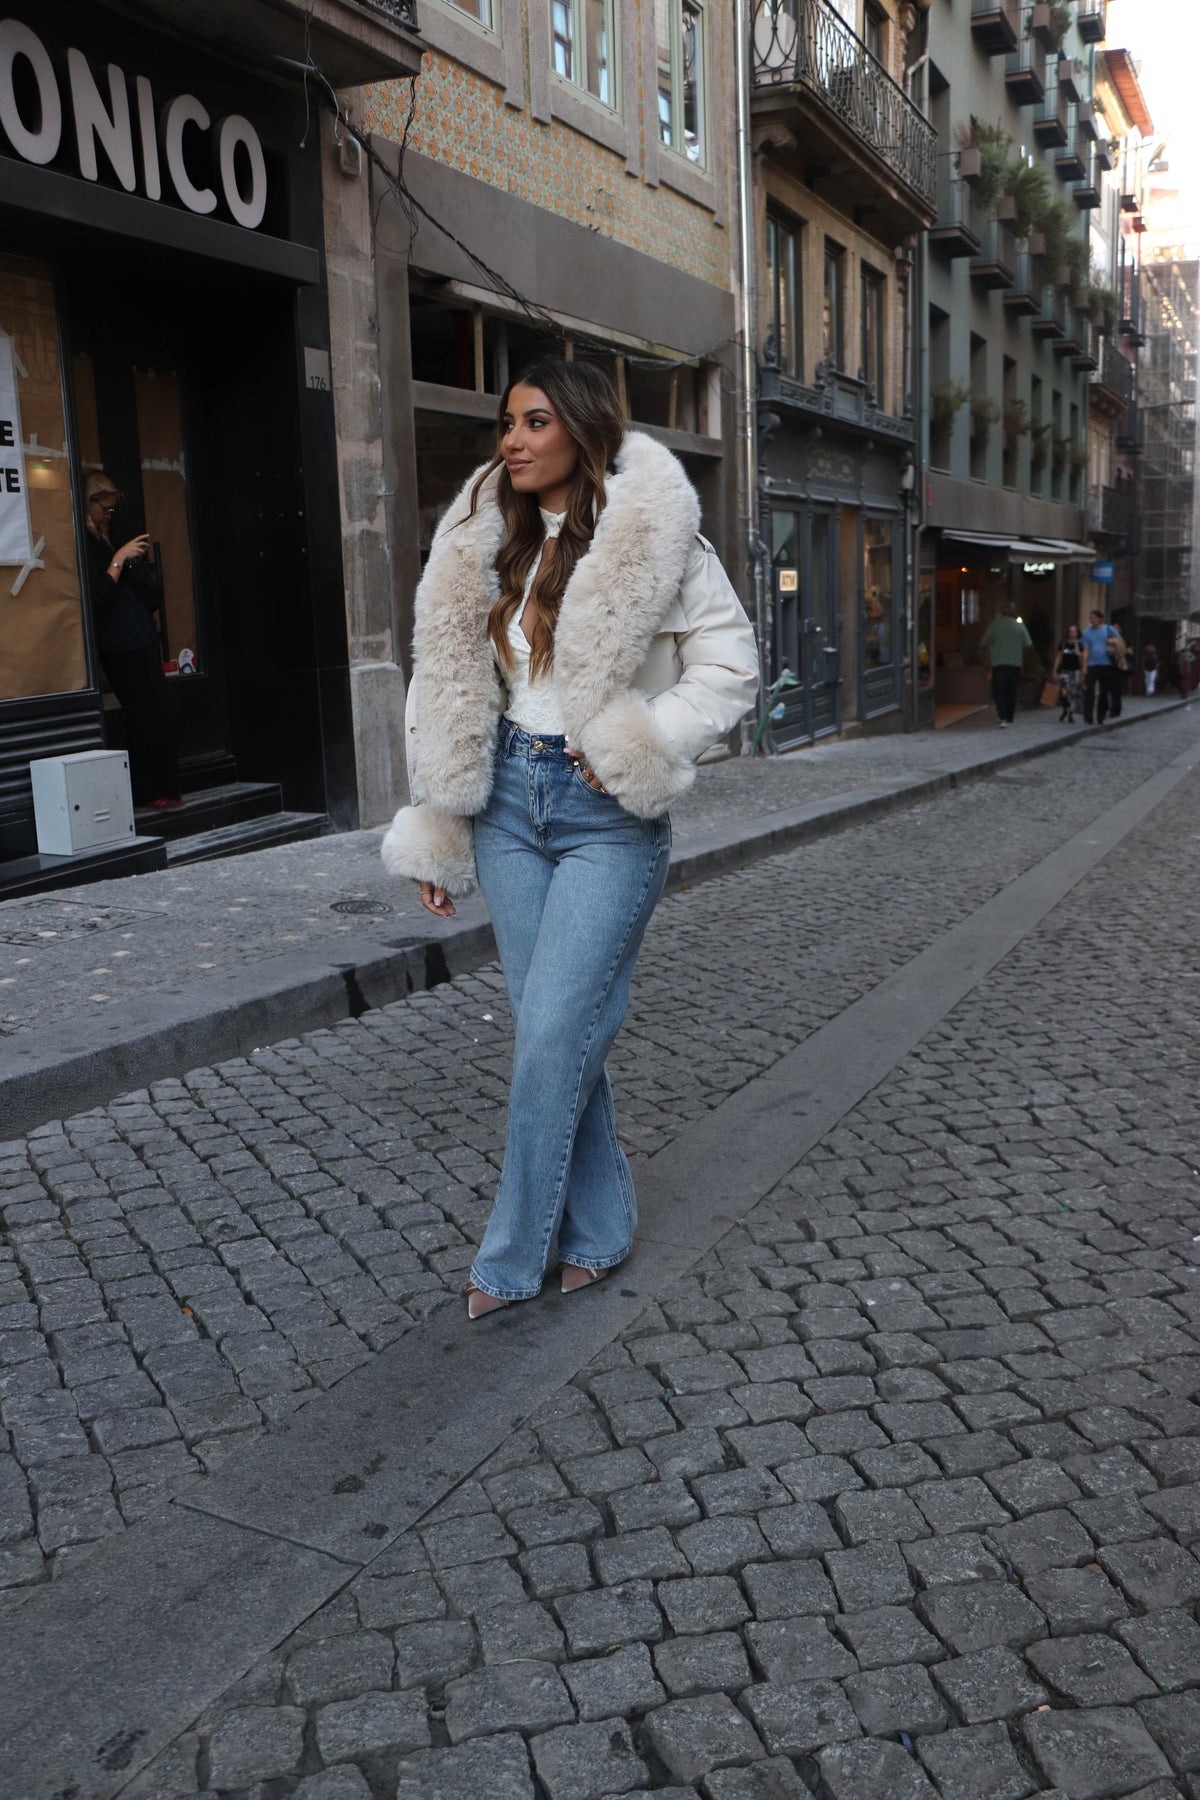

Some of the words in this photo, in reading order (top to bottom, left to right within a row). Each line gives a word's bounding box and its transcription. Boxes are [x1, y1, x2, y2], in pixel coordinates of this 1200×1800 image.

[0, 18, 267, 229] ONICO
[310, 375, 326, 391] 176
[781, 574, 796, 587] ATM
